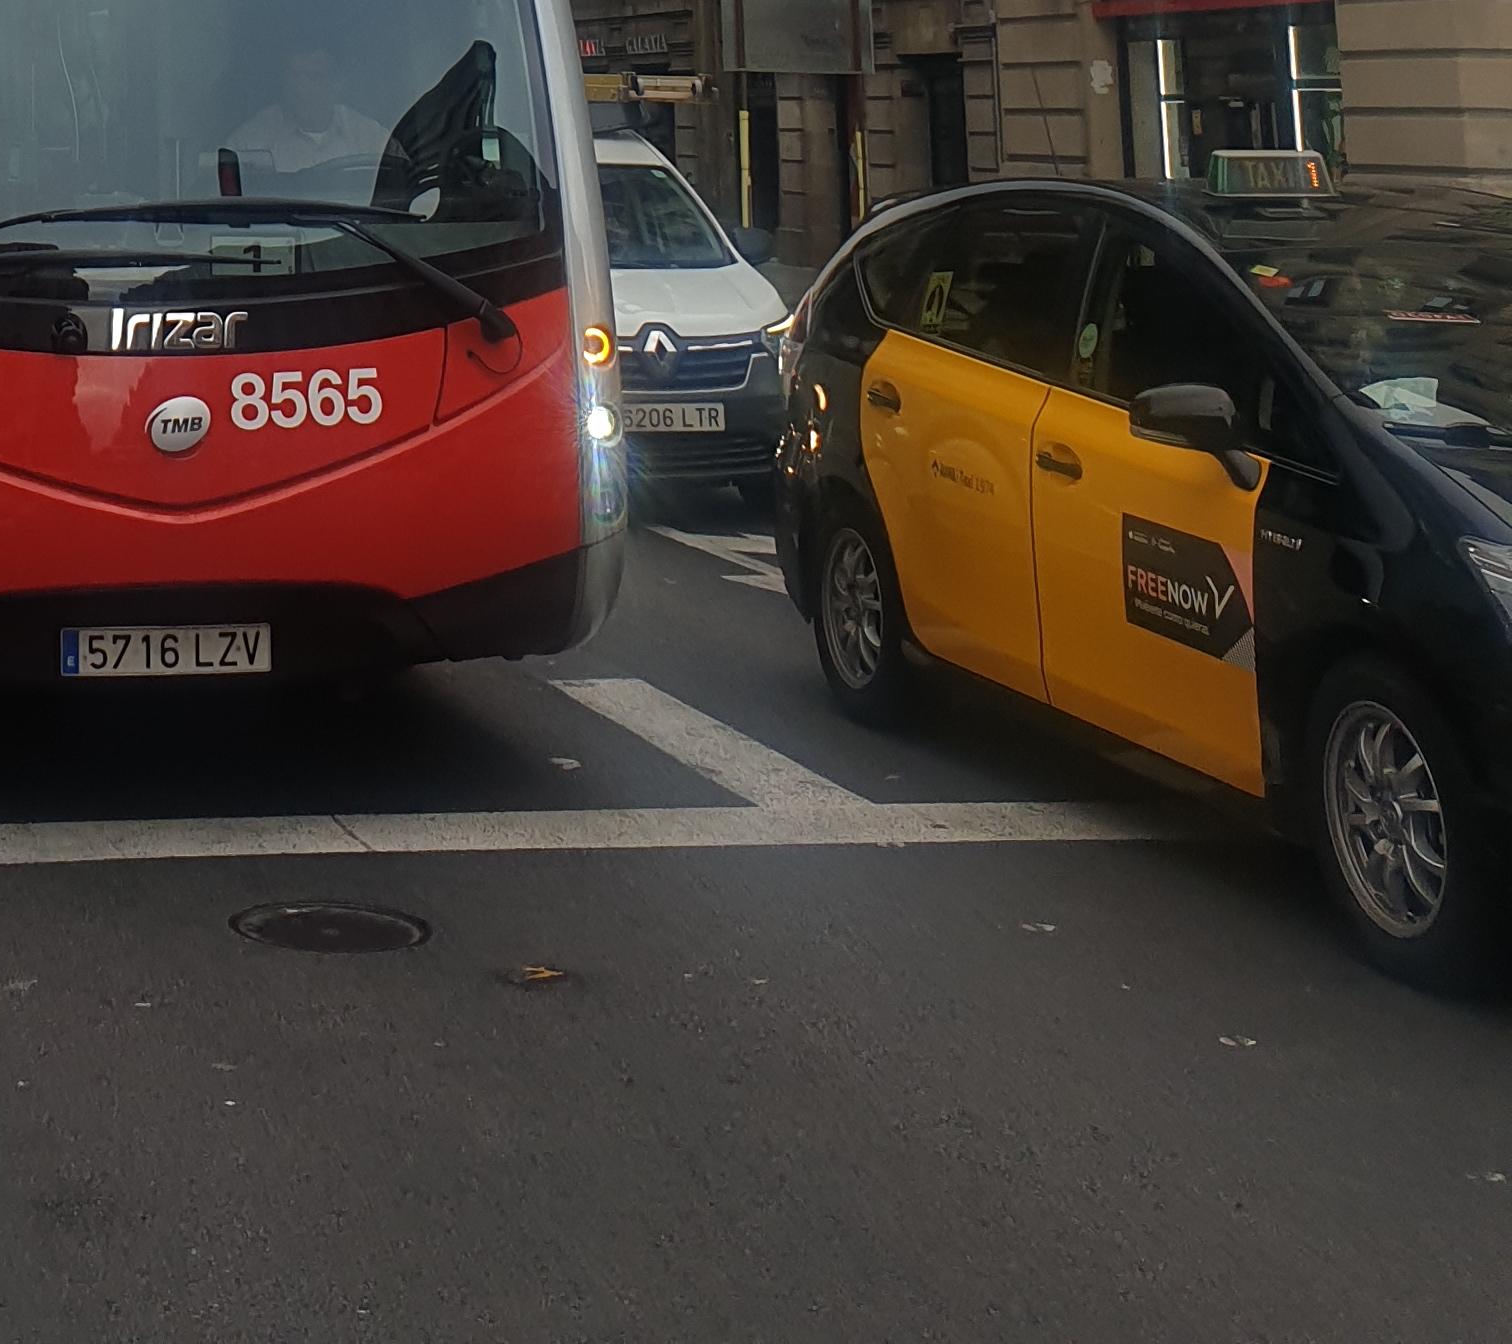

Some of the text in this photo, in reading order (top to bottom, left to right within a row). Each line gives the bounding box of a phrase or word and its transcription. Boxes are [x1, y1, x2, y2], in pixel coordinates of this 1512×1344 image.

[243, 244, 262, 273] 1
[111, 307, 249, 351] Irizar
[230, 367, 383, 431] 8565
[160, 416, 203, 435] TMB
[682, 407, 720, 428] LTR
[67, 655, 75, 667] E
[87, 630, 261, 670] 5716 LZV
